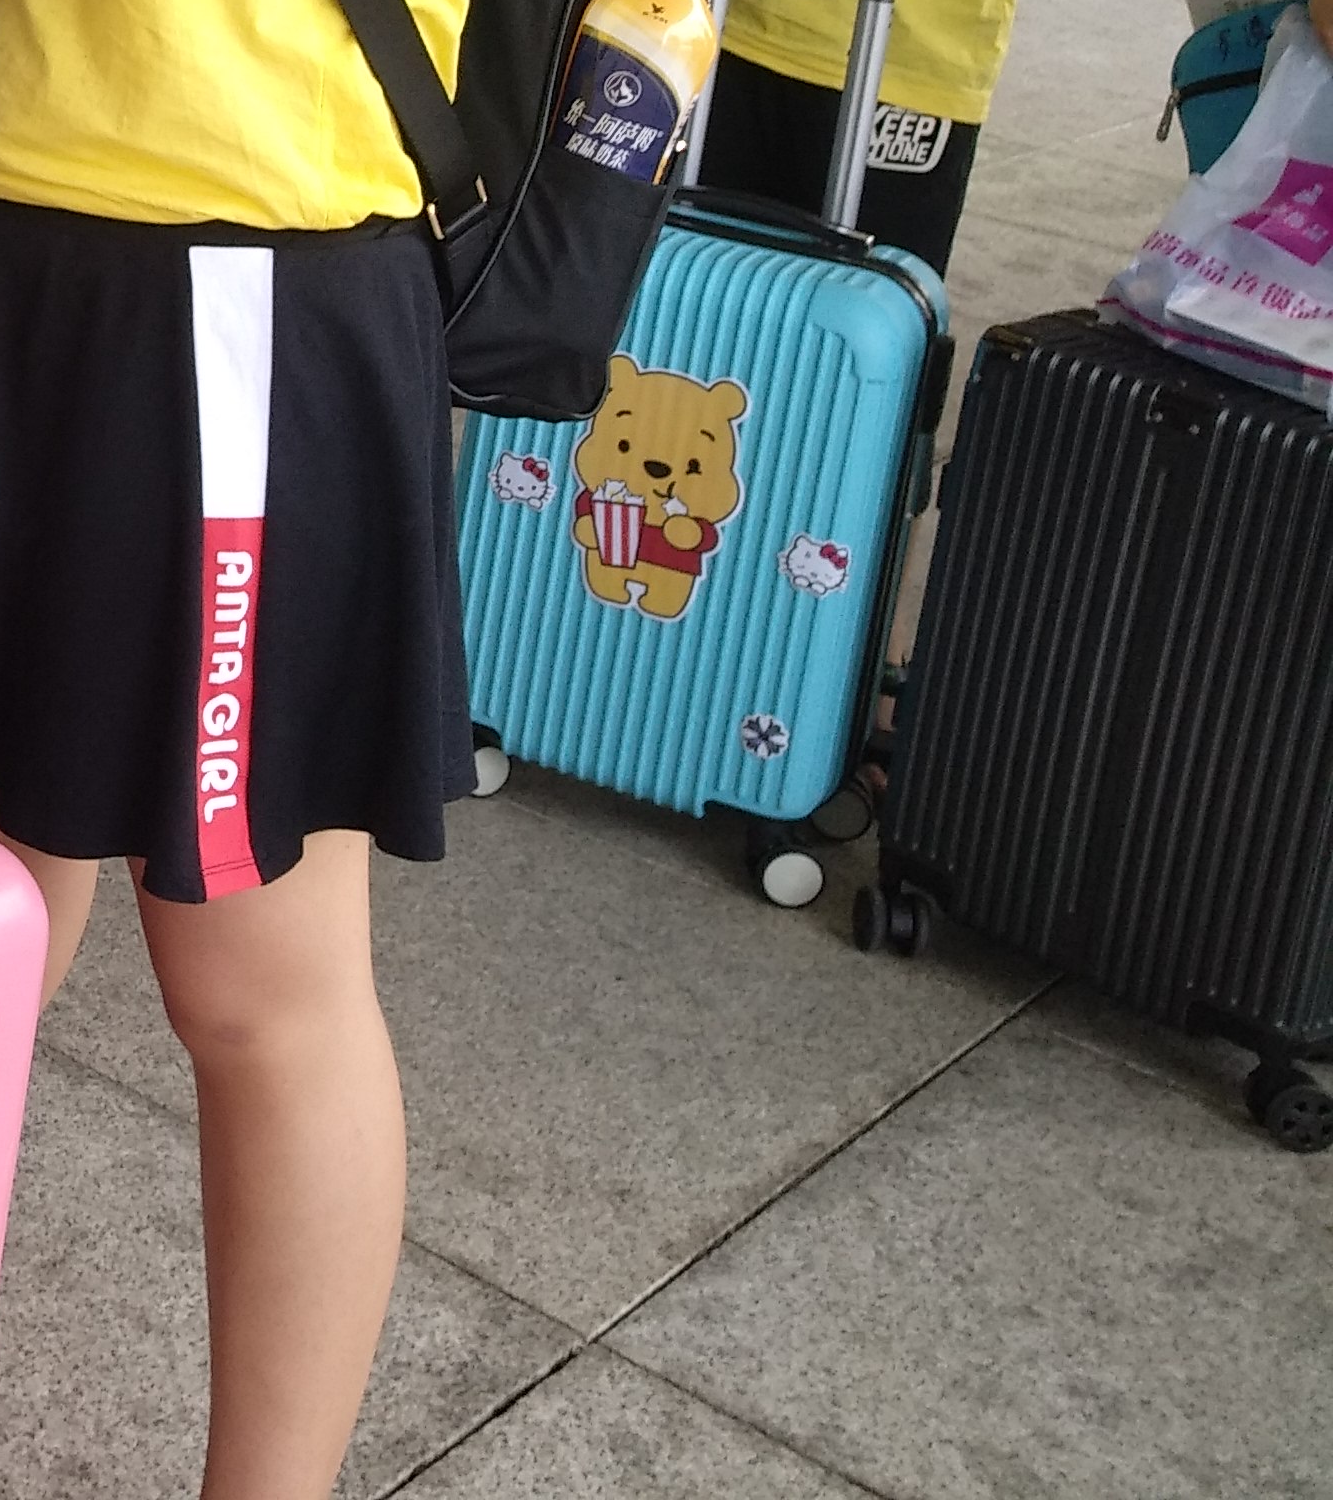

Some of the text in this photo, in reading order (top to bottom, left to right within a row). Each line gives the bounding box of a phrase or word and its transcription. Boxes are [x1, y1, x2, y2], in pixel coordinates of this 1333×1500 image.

[562, 97, 659, 153] 统一阿萨姆
[200, 693, 241, 824] GIRL
